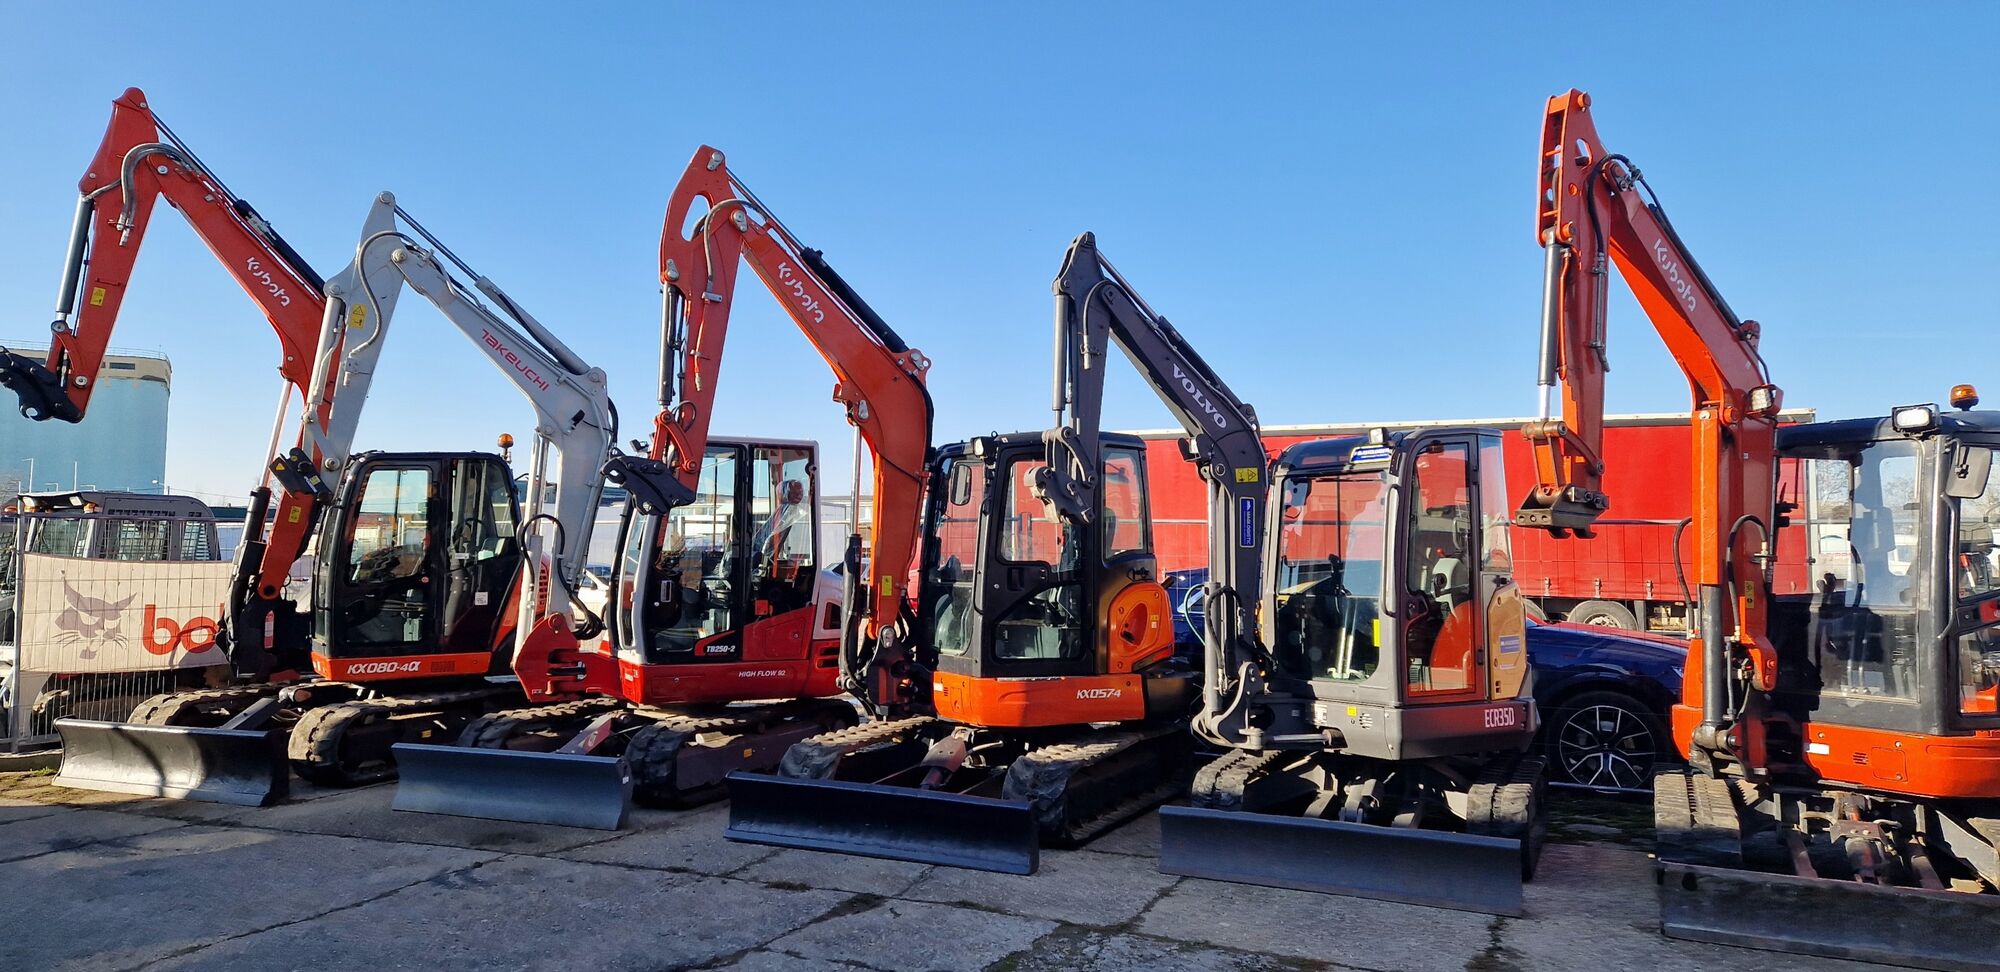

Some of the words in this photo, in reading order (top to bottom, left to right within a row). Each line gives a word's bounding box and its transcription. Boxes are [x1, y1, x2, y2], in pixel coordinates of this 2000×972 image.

[247, 256, 290, 307] Kubota
[778, 261, 824, 323] Kubota
[1654, 238, 1697, 312] Kubota
[1173, 363, 1227, 428] VOLVO
[142, 603, 225, 656] bo
[706, 645, 736, 653] TB250-2
[738, 670, 757, 678] HIGH
[757, 669, 777, 677] FLOW
[1484, 707, 1515, 728] ECR35D
